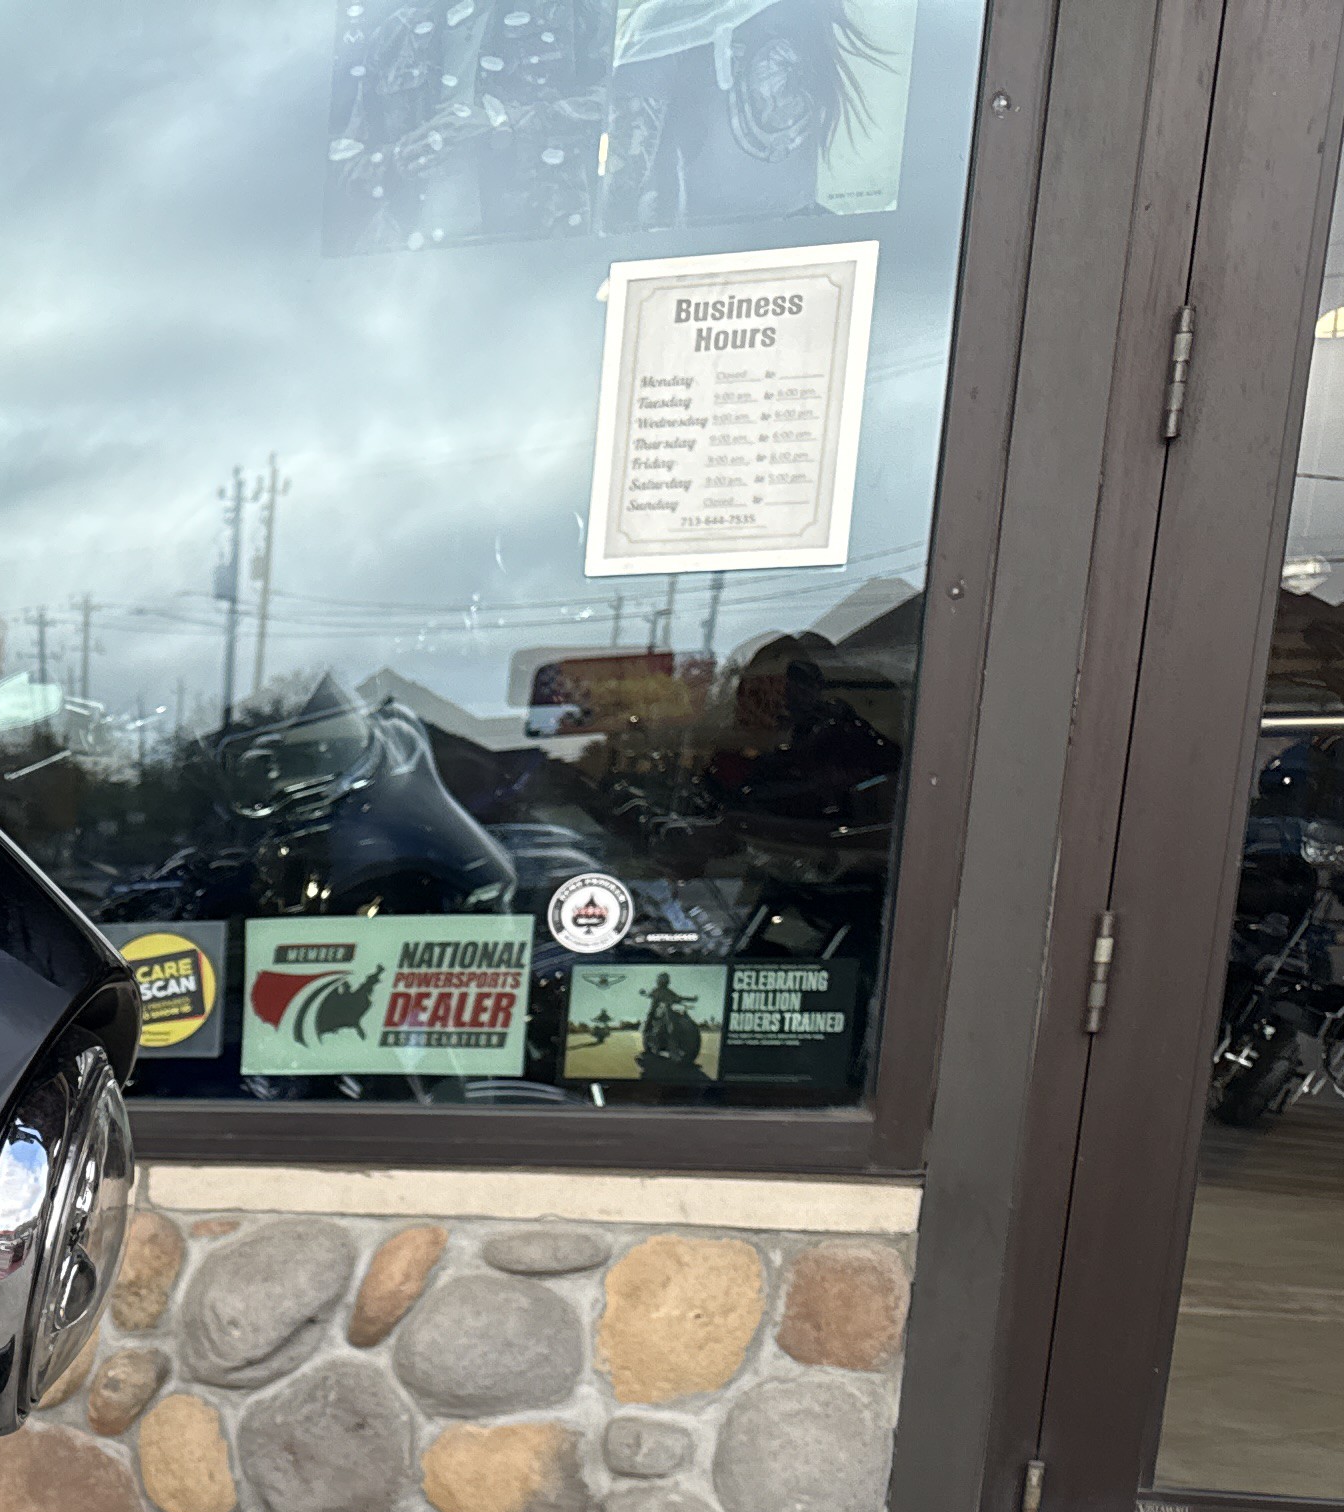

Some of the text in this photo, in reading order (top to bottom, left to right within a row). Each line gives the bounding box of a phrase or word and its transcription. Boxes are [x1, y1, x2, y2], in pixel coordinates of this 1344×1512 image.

[674, 294, 803, 323] Business
[694, 326, 776, 352] Hours
[640, 375, 694, 389] Monday
[637, 396, 692, 410] Tuesday
[636, 416, 708, 429] Wednesday
[633, 437, 697, 451] Thursday
[631, 457, 676, 471] Friday
[629, 478, 692, 492] Saturday
[627, 499, 679, 512] Sunday
[286, 946, 345, 961] MEMBER
[398, 941, 528, 969] NATIONAL
[135, 958, 192, 982] CARE
[140, 976, 196, 1001] SCAN
[392, 971, 522, 990] POWERSPORTS
[733, 970, 828, 991] CELEBRATING
[384, 992, 517, 1028] DEALER
[732, 992, 802, 1011] 1 MILLION
[729, 1012, 844, 1033] RIDERS TRAINED
[386, 1032, 500, 1047] ASSOCIATION
